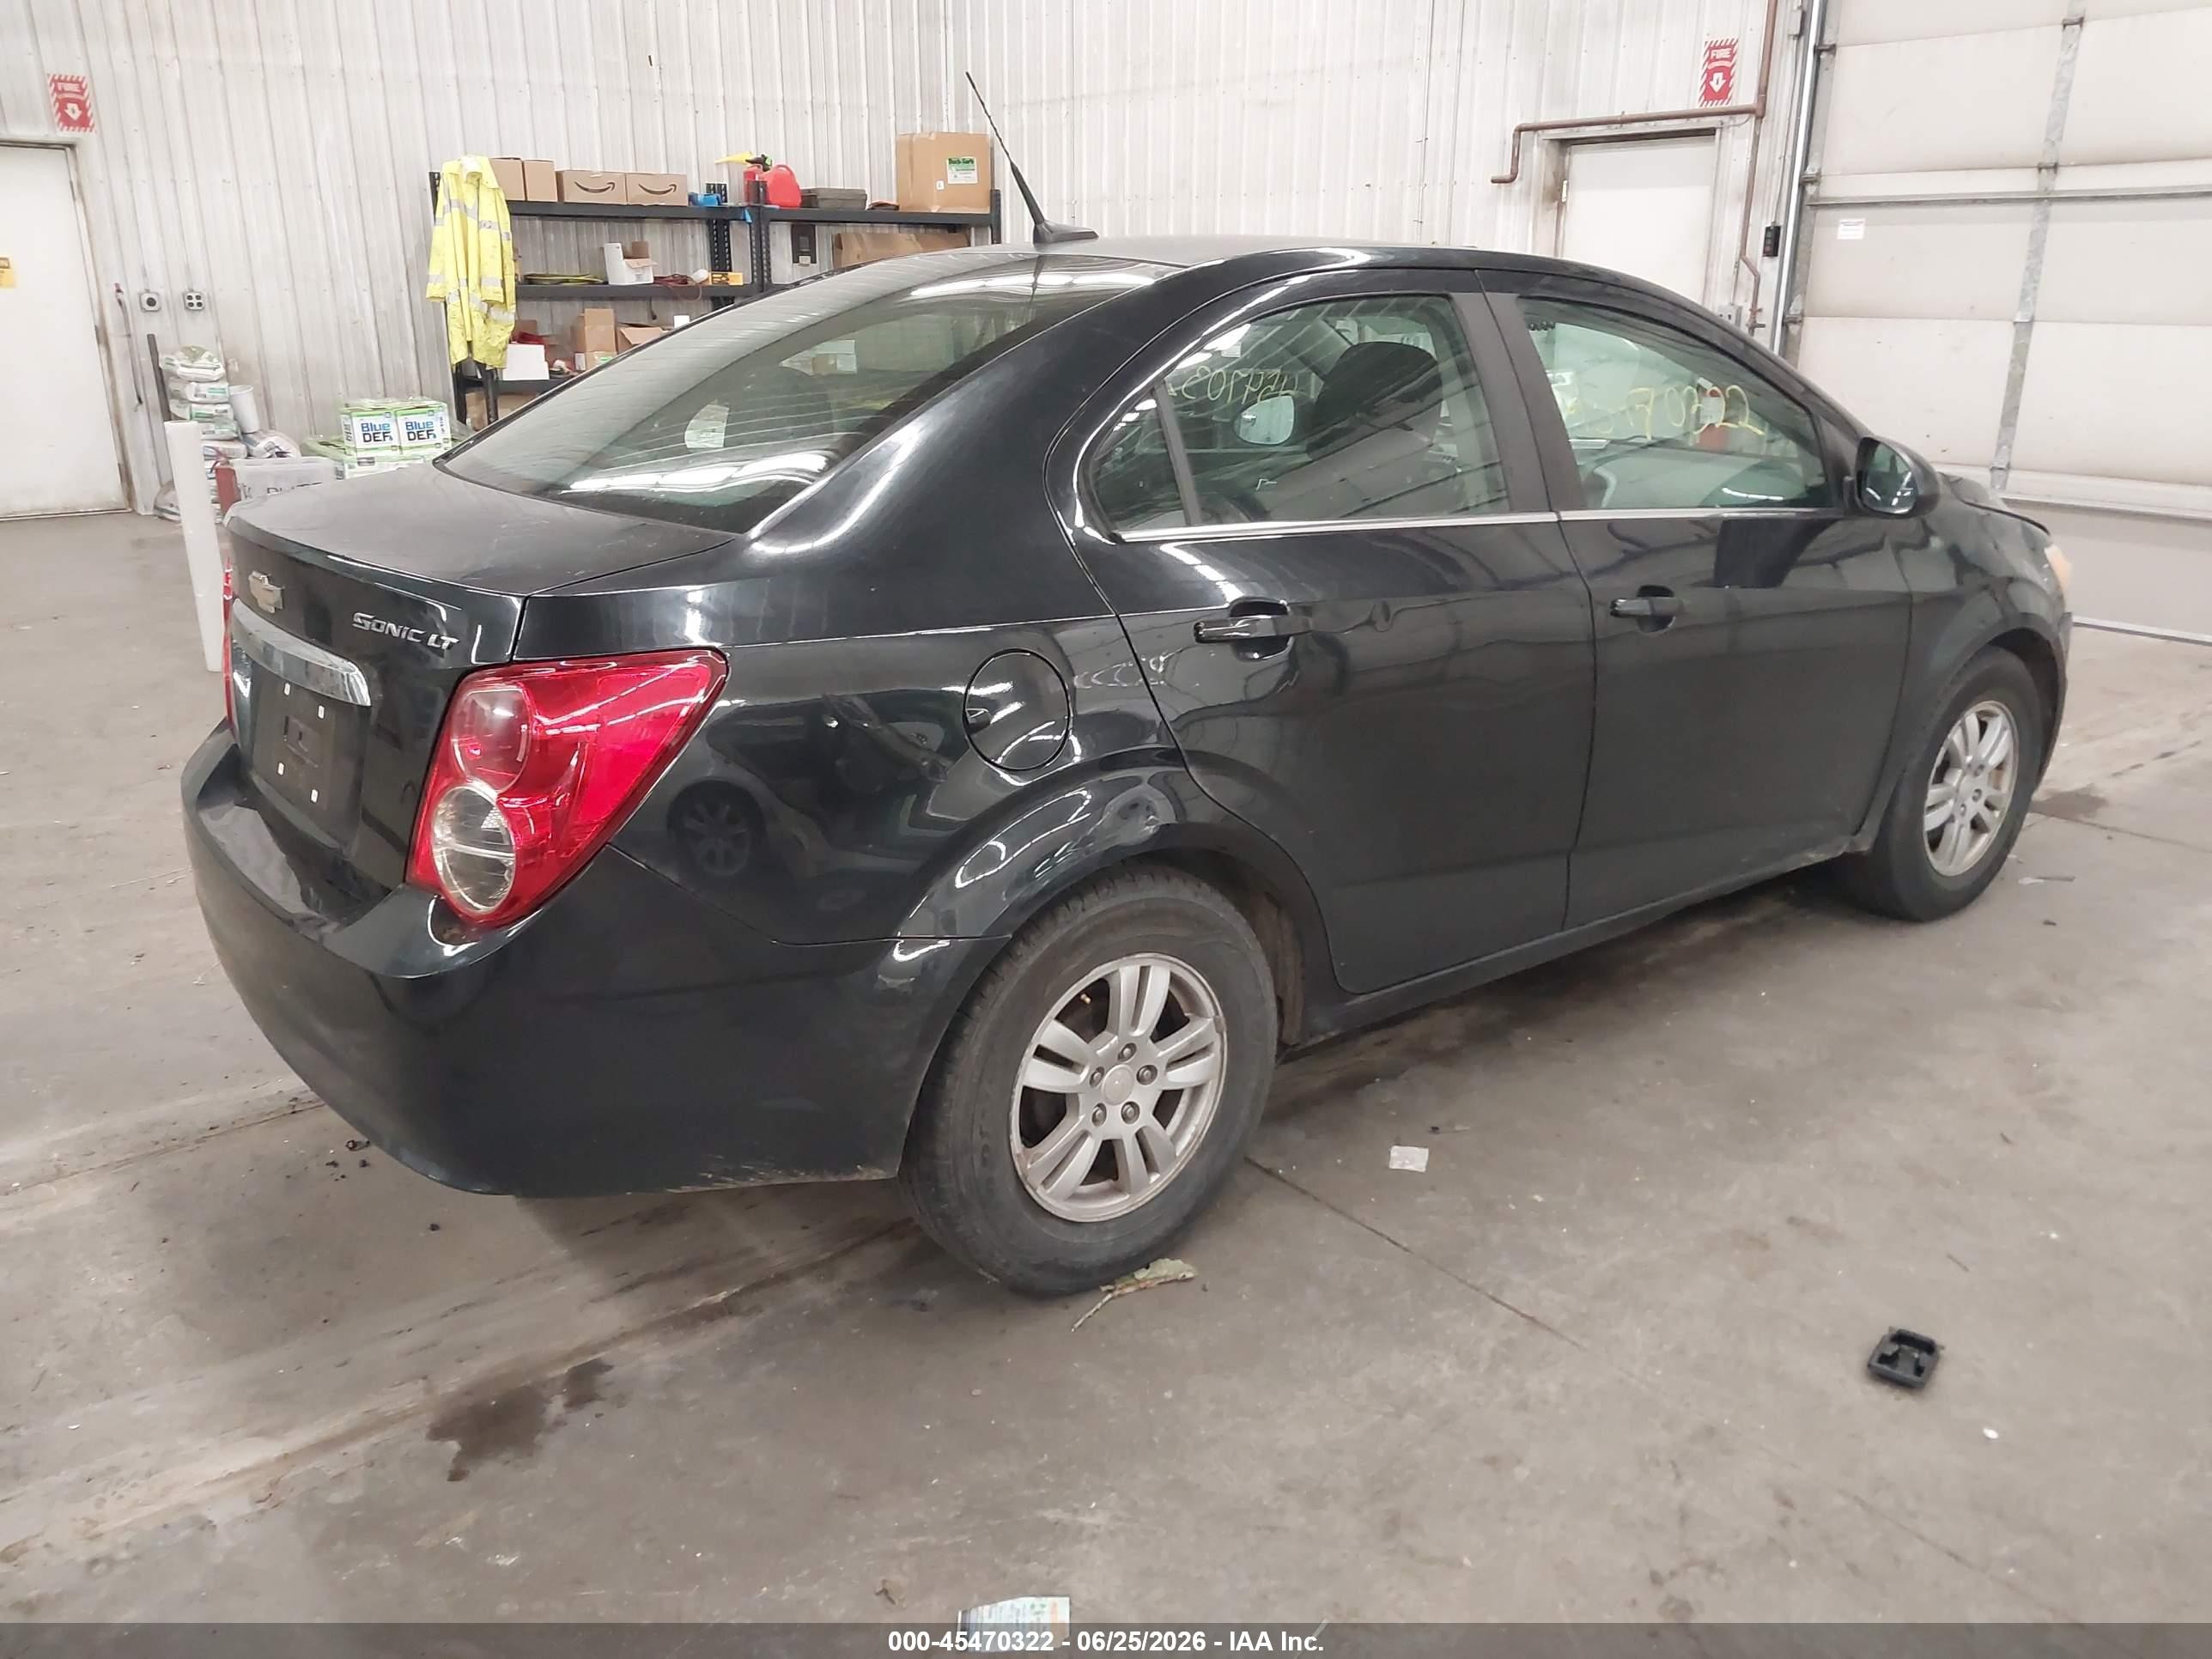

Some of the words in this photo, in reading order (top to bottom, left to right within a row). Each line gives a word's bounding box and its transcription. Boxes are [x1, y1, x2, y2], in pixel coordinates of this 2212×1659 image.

[361, 422, 391, 432] Blue
[405, 421, 434, 430] Blue
[362, 431, 392, 442] DEF
[407, 429, 435, 441] DEF
[352, 612, 426, 642] SONIC
[427, 634, 460, 649] LT
